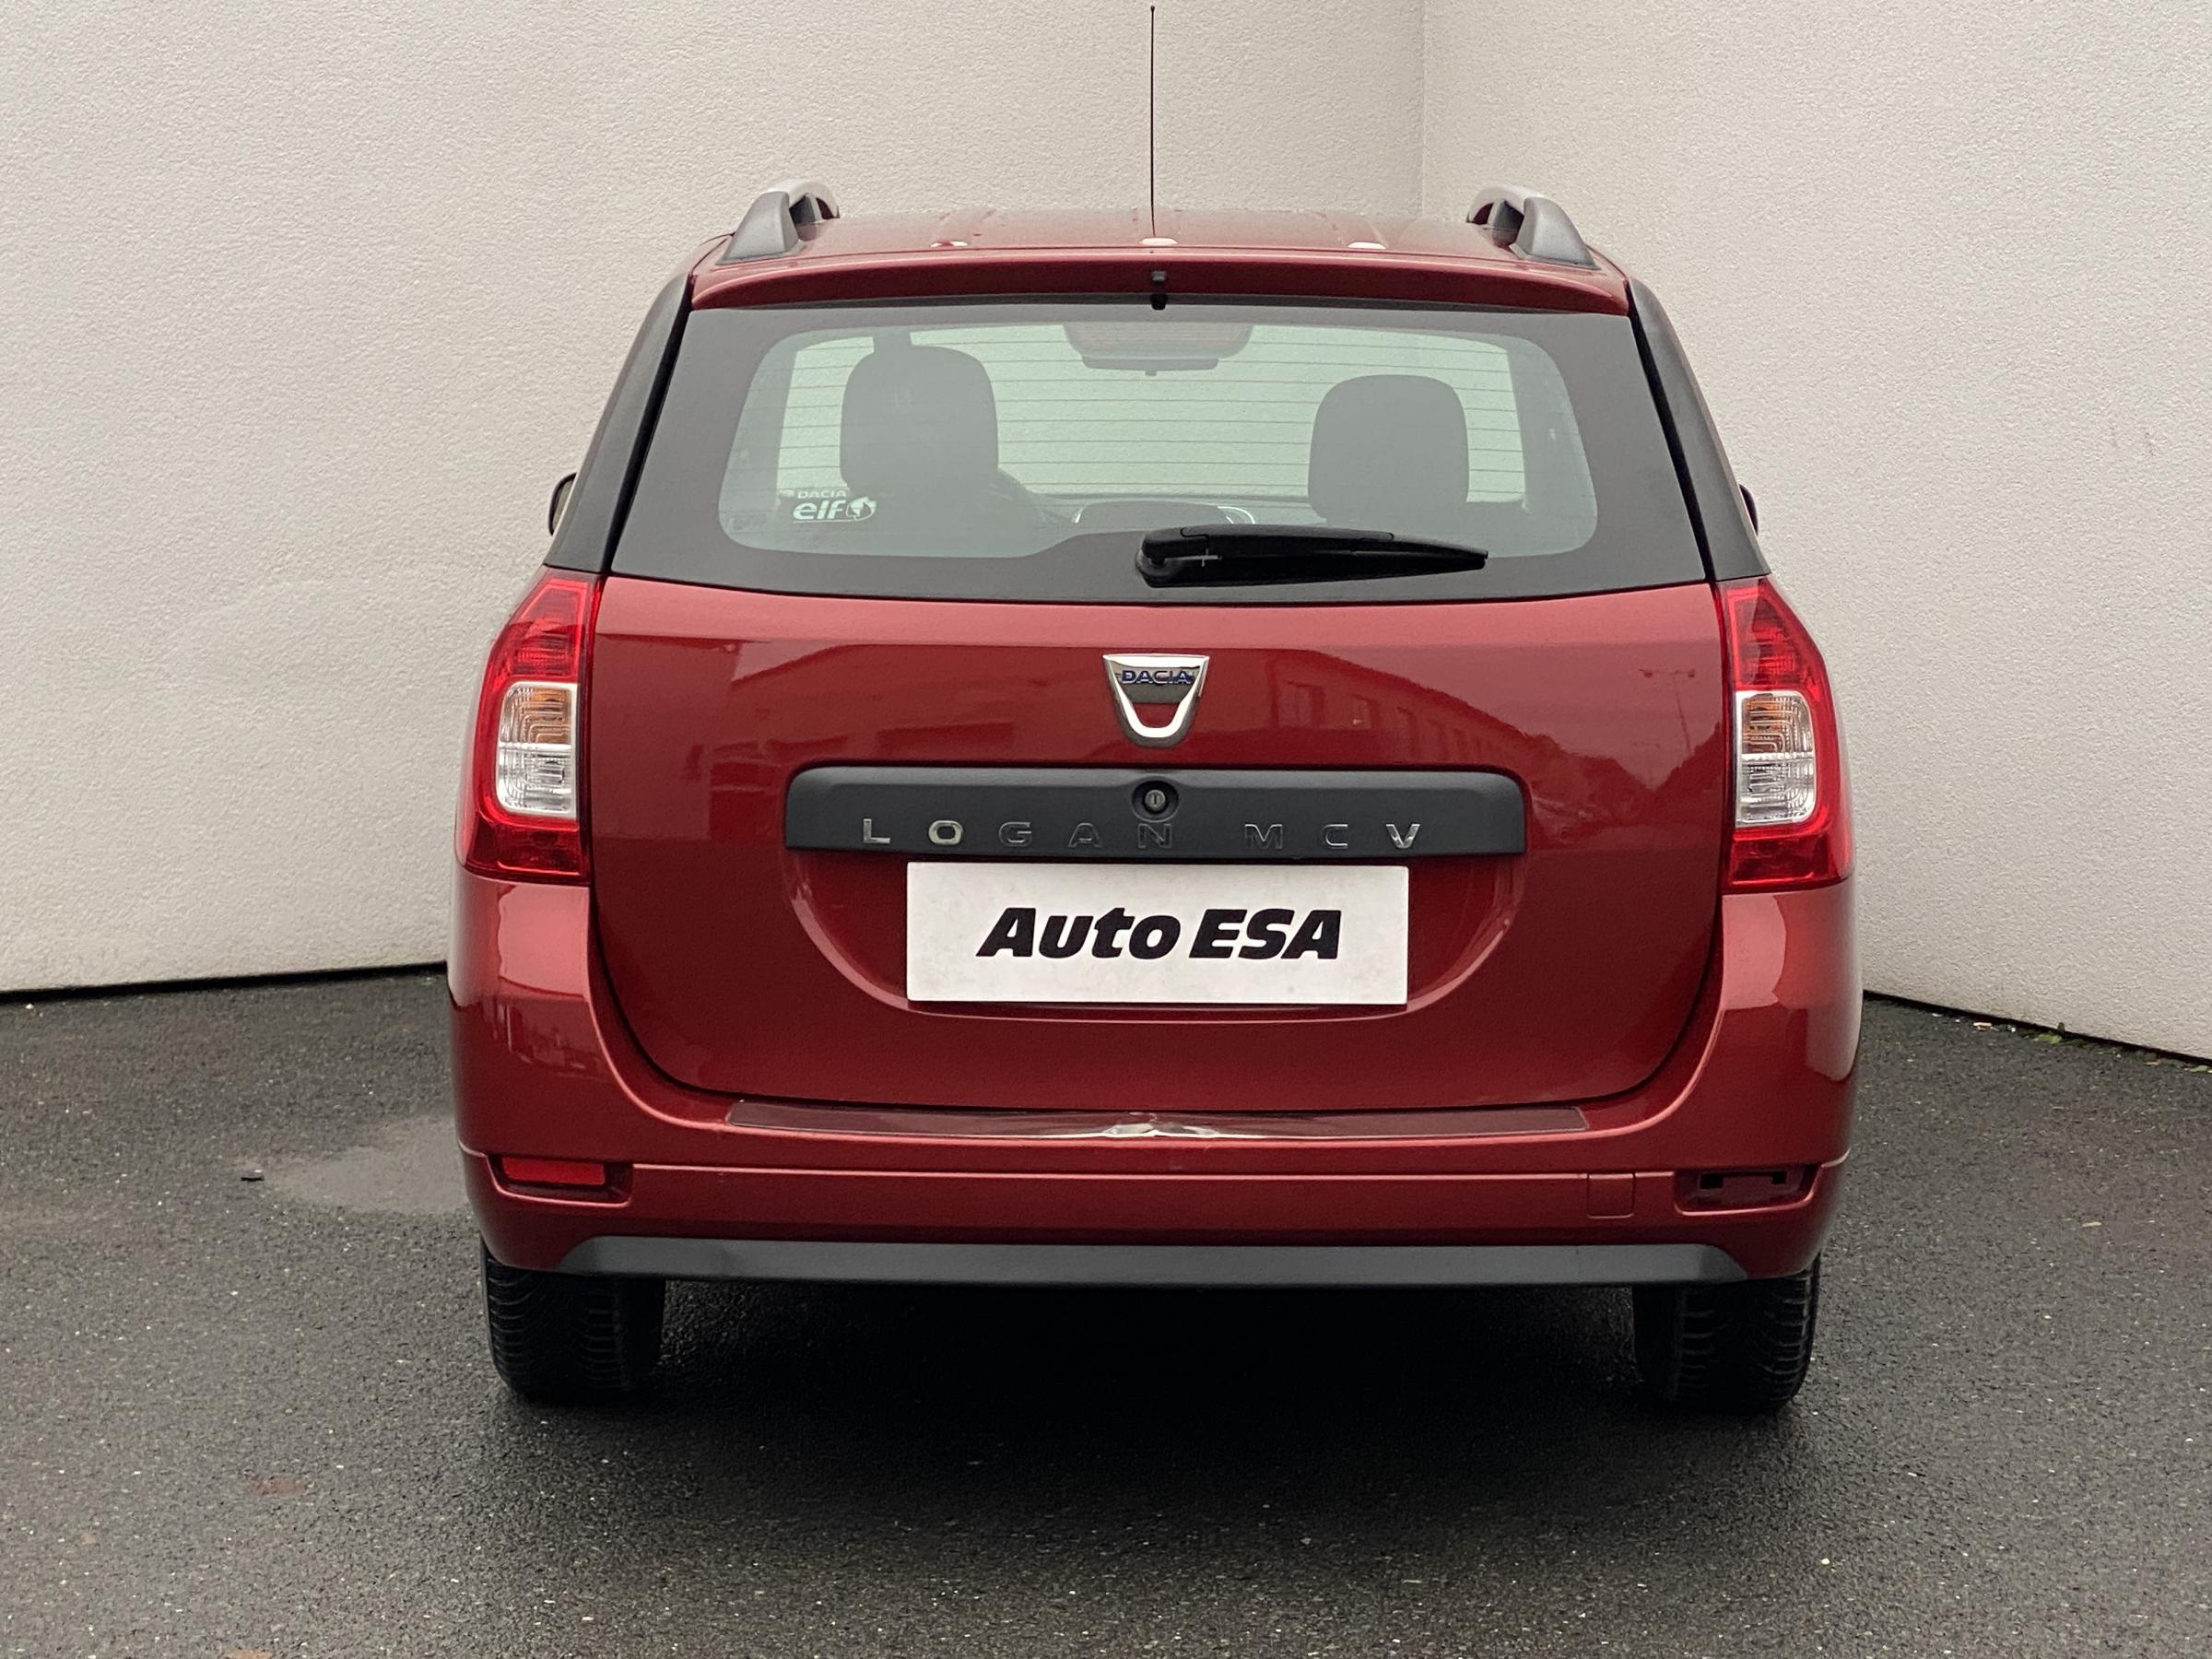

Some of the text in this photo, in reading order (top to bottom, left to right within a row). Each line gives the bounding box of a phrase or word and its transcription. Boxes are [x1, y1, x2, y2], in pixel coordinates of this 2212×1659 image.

[797, 490, 847, 499] DACIA
[793, 500, 846, 520] elf
[1121, 670, 1195, 684] DACIA
[863, 818, 1420, 849] LOGAN MCV
[976, 907, 1342, 959] Auto ESA
